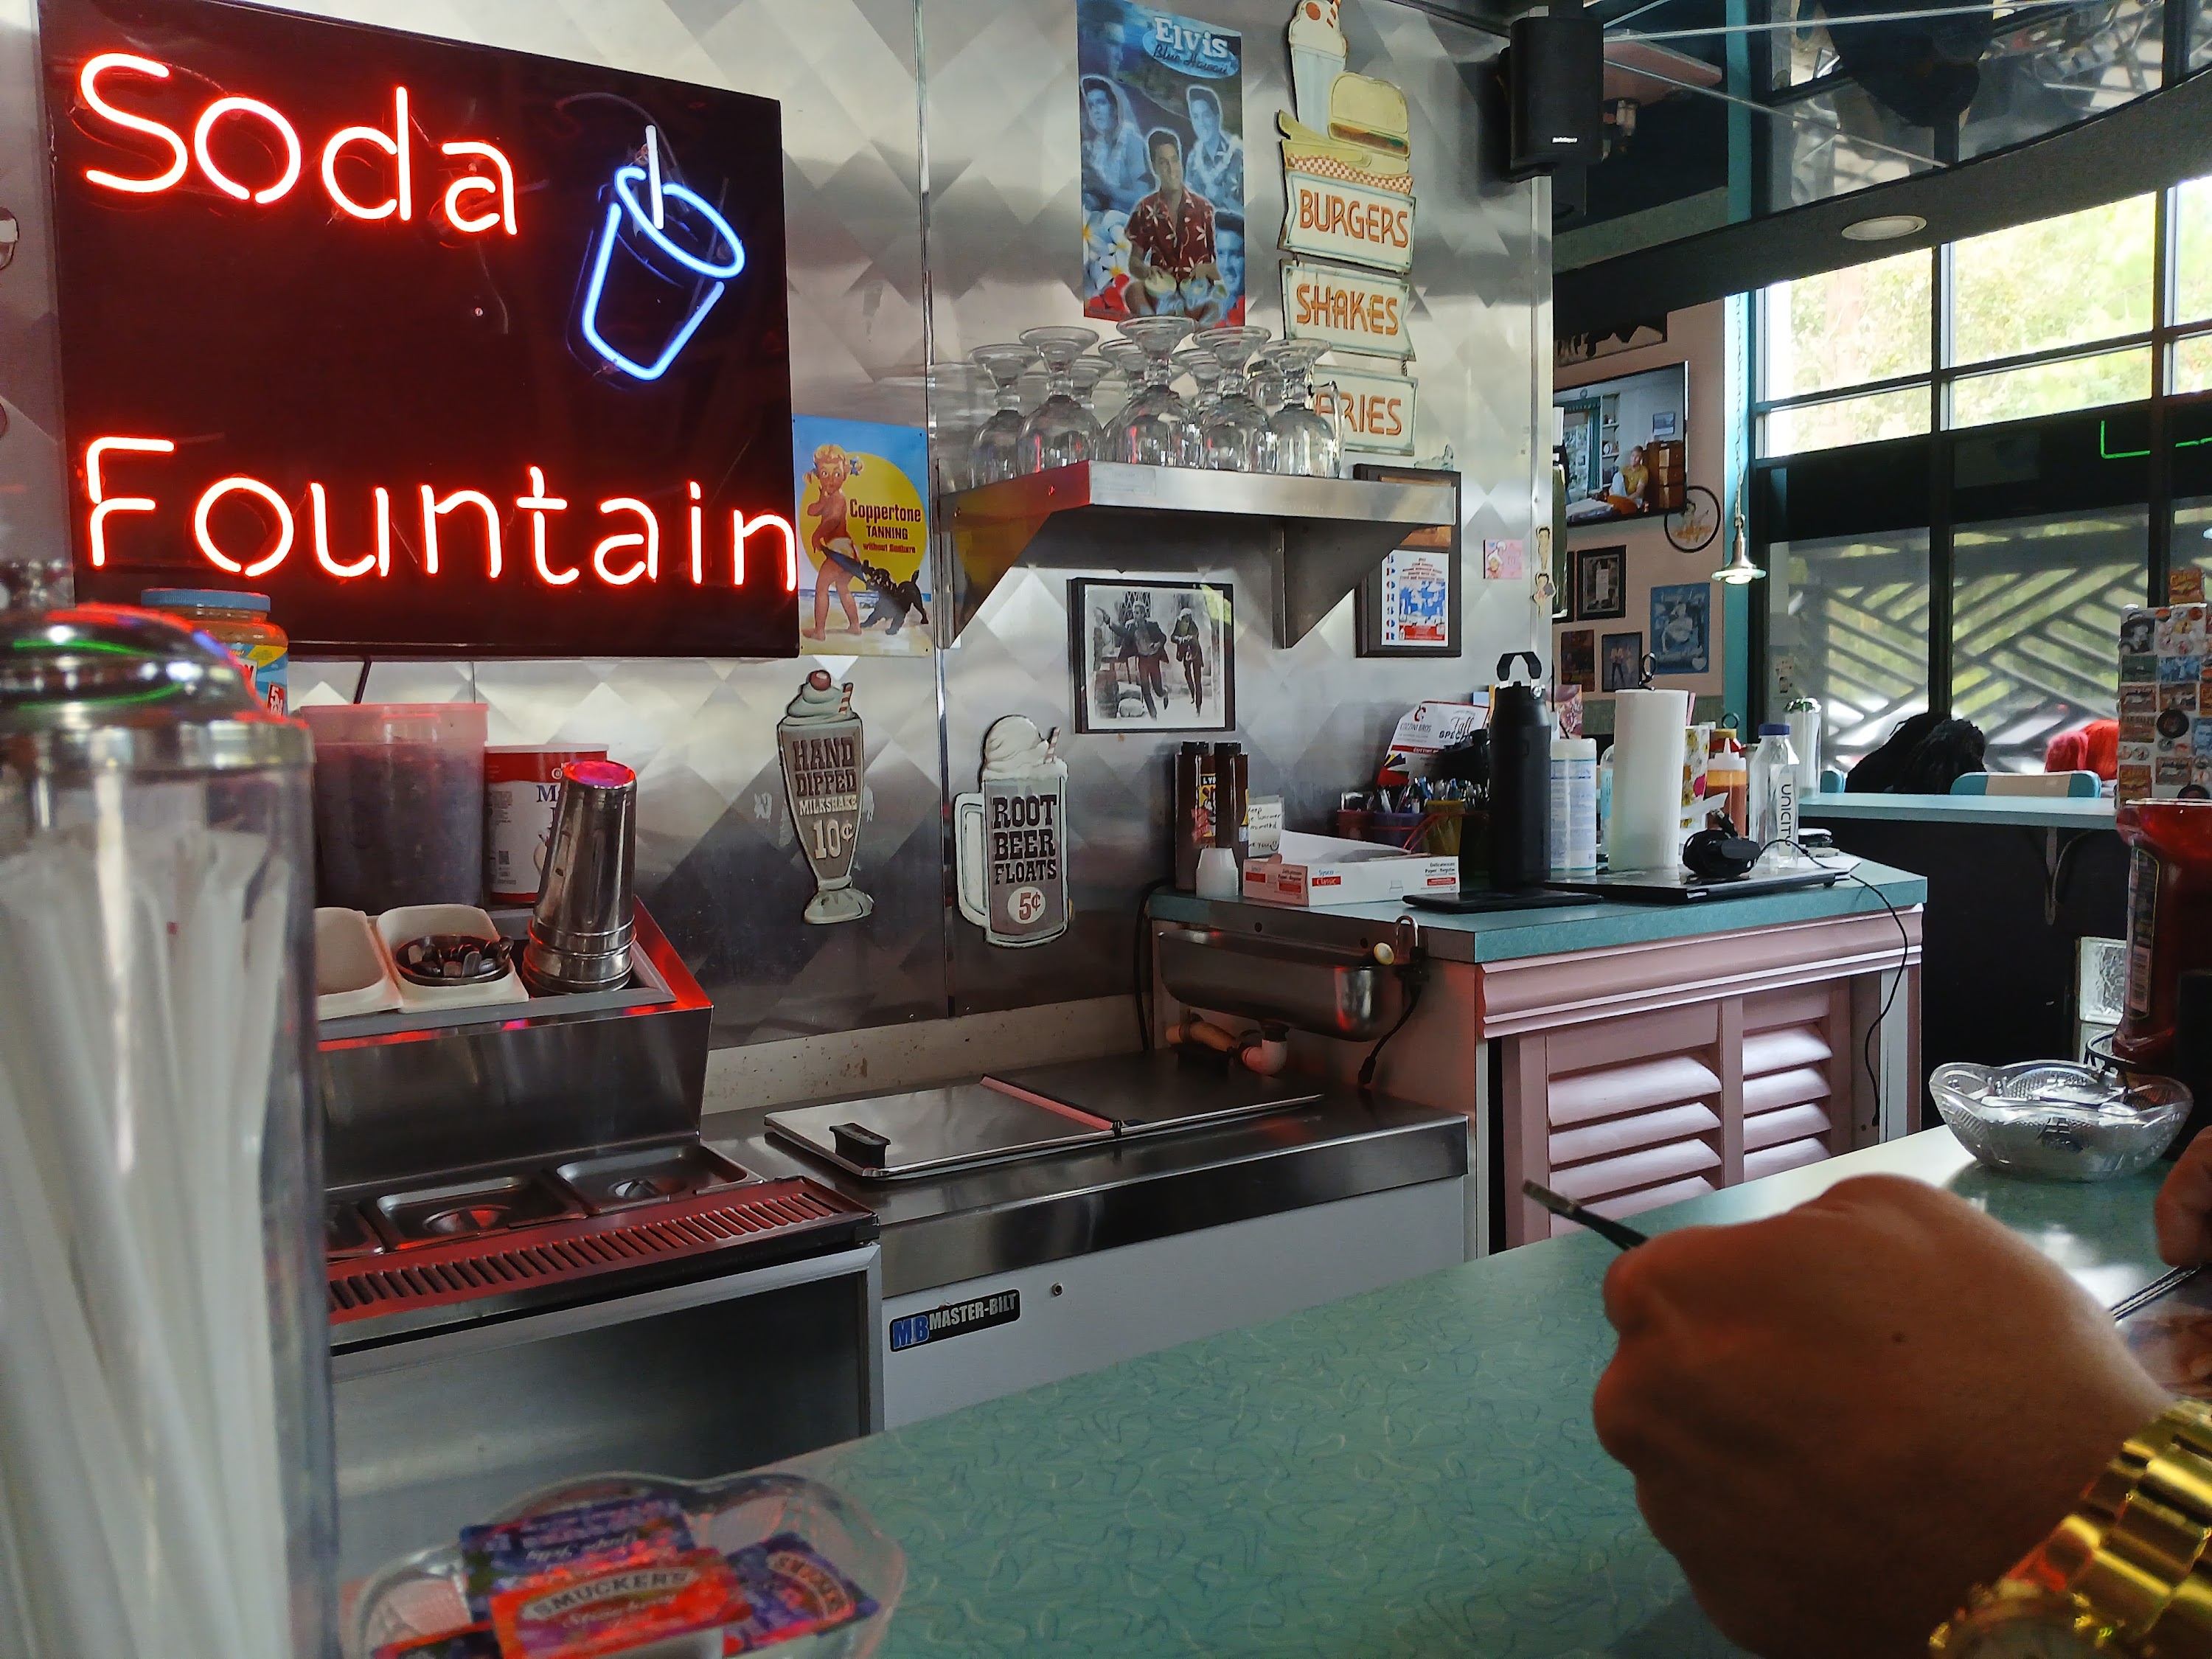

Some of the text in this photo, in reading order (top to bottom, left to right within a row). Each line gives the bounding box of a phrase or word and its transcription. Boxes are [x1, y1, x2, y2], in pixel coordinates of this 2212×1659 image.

[1154, 17, 1228, 58] Elvis
[78, 52, 519, 237] Soda
[1299, 189, 1408, 248] BURGERS
[1296, 283, 1399, 335] SHAKES
[85, 435, 798, 592] Fountain
[849, 498, 922, 524] Coppertone
[866, 525, 908, 540] TANNING
[1419, 724, 1432, 732] BROS
[793, 736, 855, 771] HAND
[795, 768, 857, 797] DIPPED
[799, 793, 858, 816] MILKSHAKE
[991, 794, 1057, 829] ROOT
[1780, 784, 1792, 846] UNICITY
[993, 829, 1057, 862] BEER
[995, 859, 1057, 885] FLOATS
[1316, 877, 1336, 886] Classic
[929, 1293, 1017, 1331] MASTER-BILT
